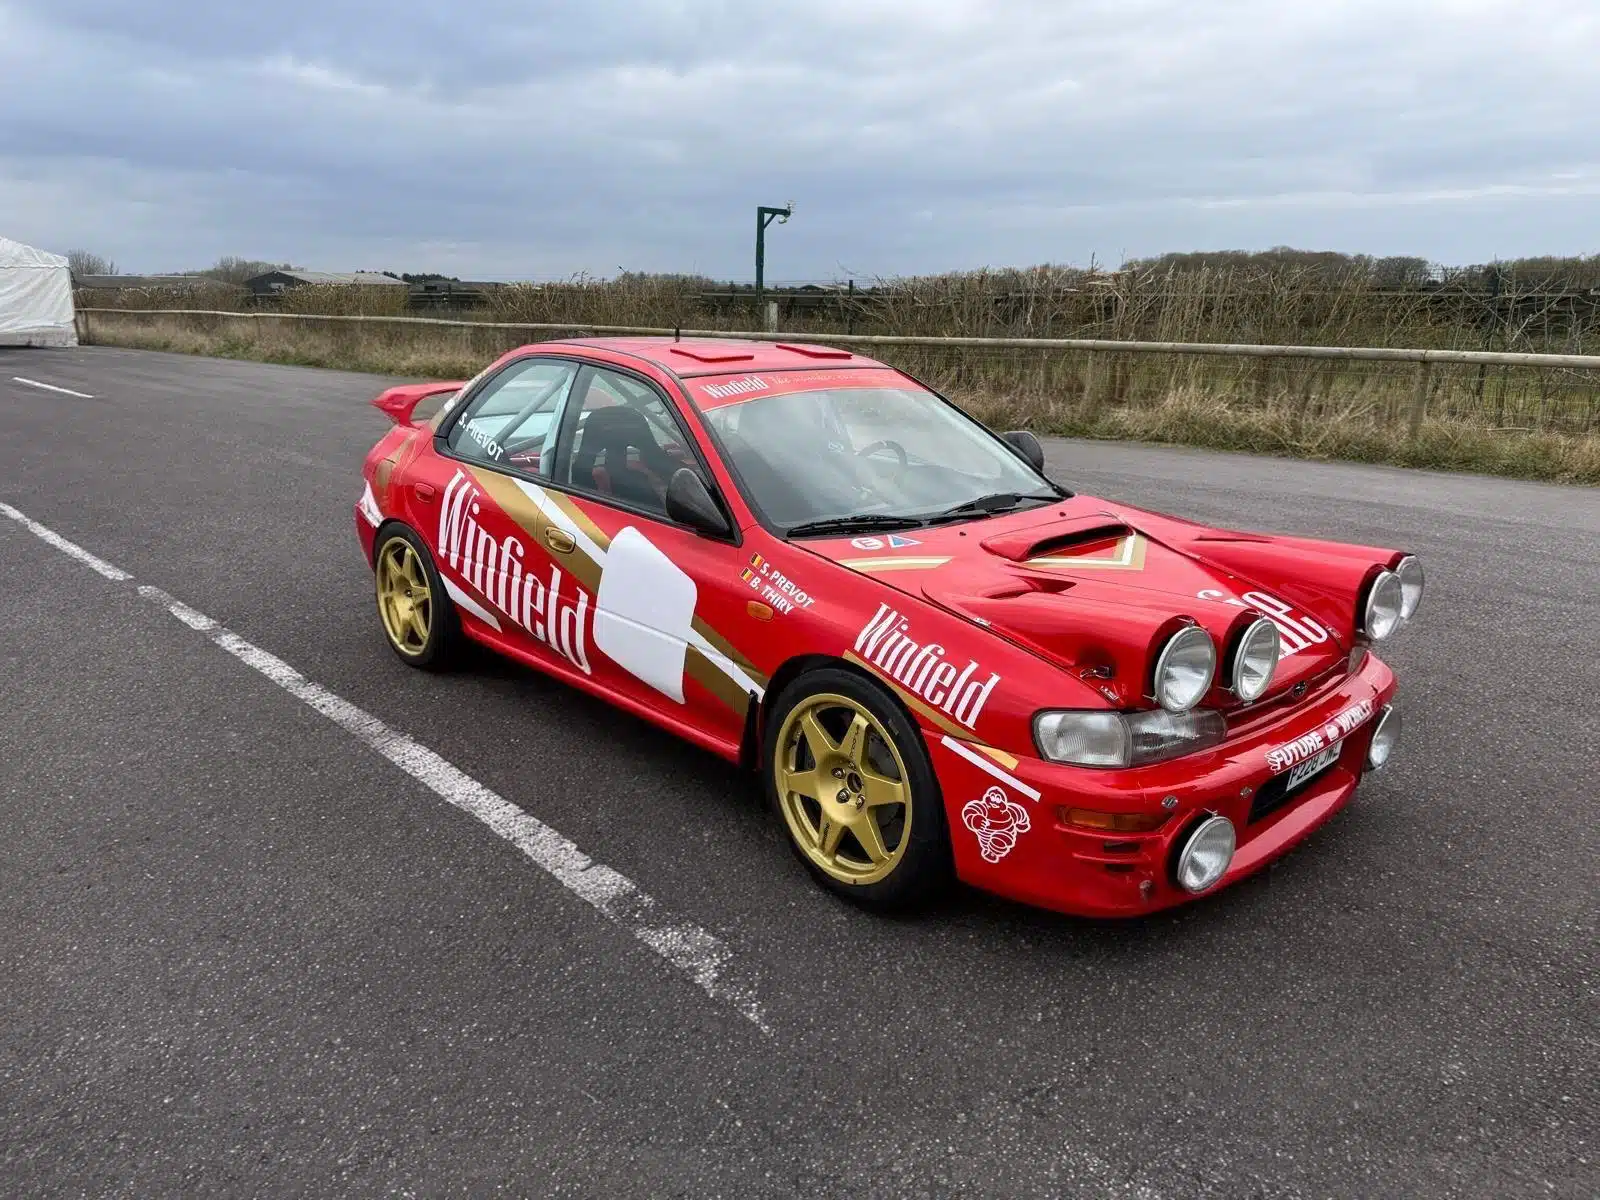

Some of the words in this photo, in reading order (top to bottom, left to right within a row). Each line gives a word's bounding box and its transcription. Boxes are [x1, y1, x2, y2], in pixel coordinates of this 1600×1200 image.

[700, 376, 769, 399] Winfield
[438, 468, 592, 675] Winfield
[769, 569, 815, 608] PREVOT
[760, 585, 794, 615] THIRY
[853, 602, 1001, 731] Winfield
[1270, 731, 1324, 771] FUTURE
